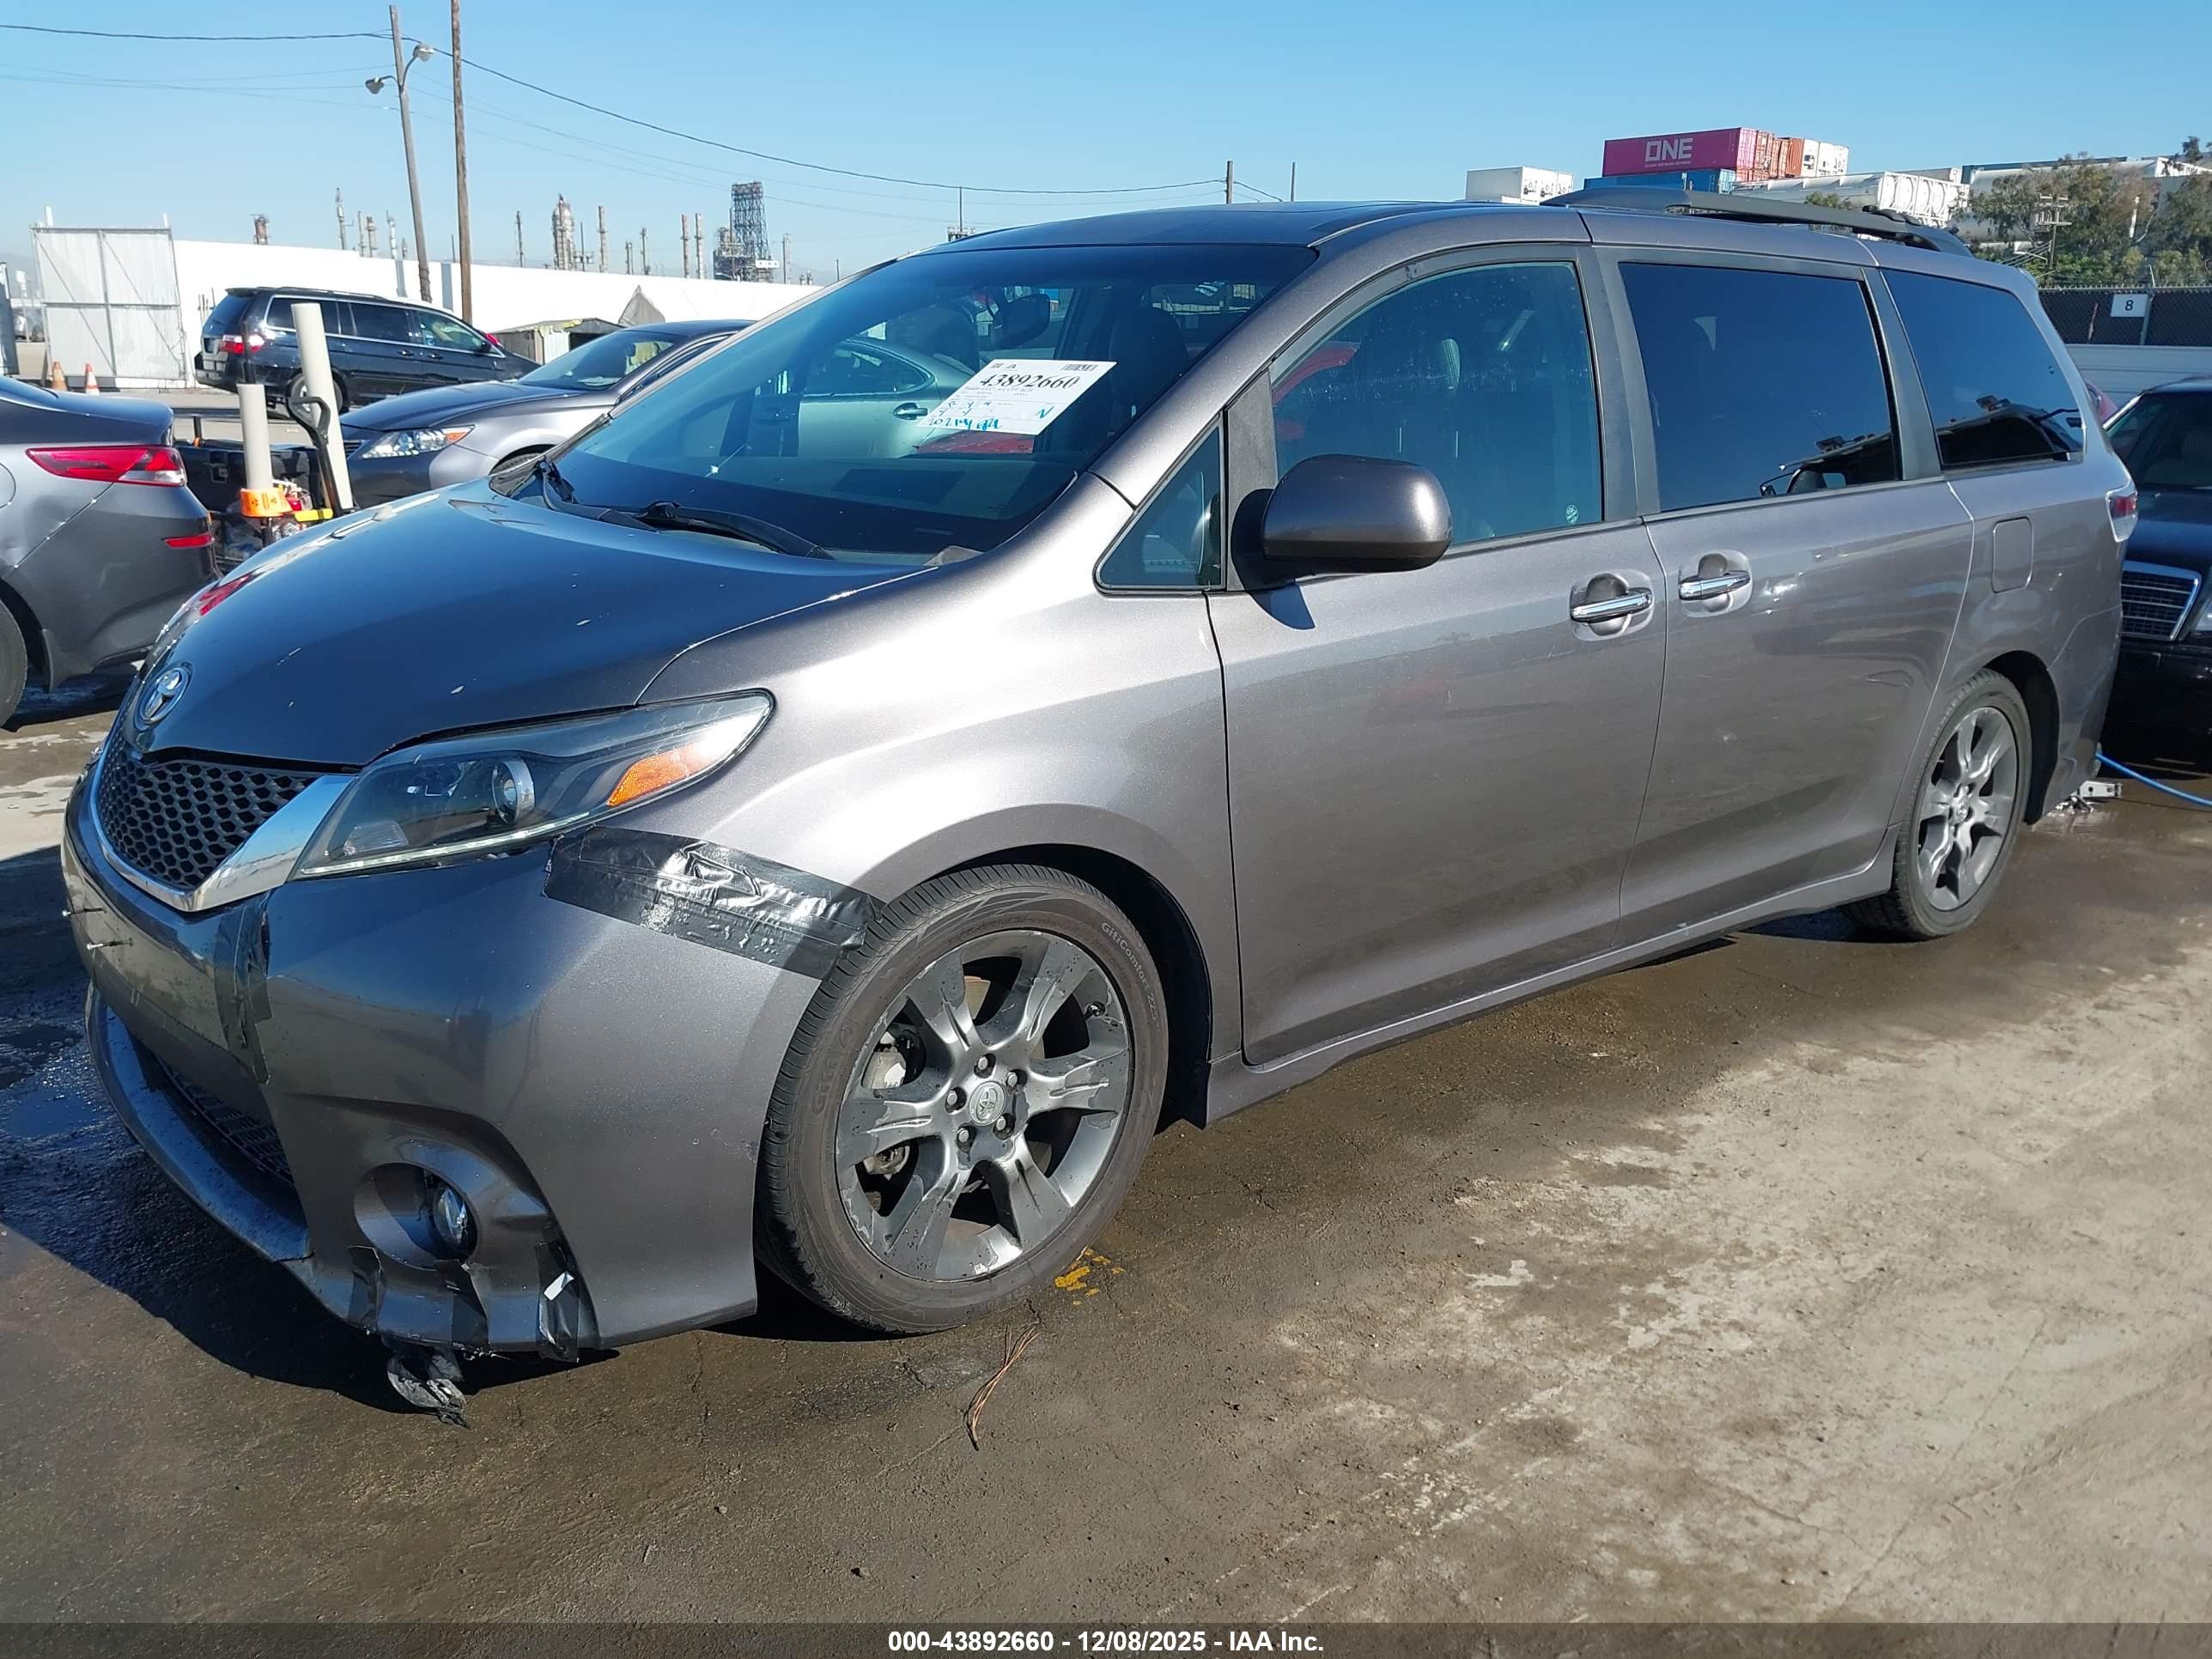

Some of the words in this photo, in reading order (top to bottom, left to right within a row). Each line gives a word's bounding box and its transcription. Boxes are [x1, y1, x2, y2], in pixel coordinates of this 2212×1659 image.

[1645, 137, 1693, 162] ONE
[2124, 299, 2135, 311] 8
[979, 374, 1081, 389] 43892660
